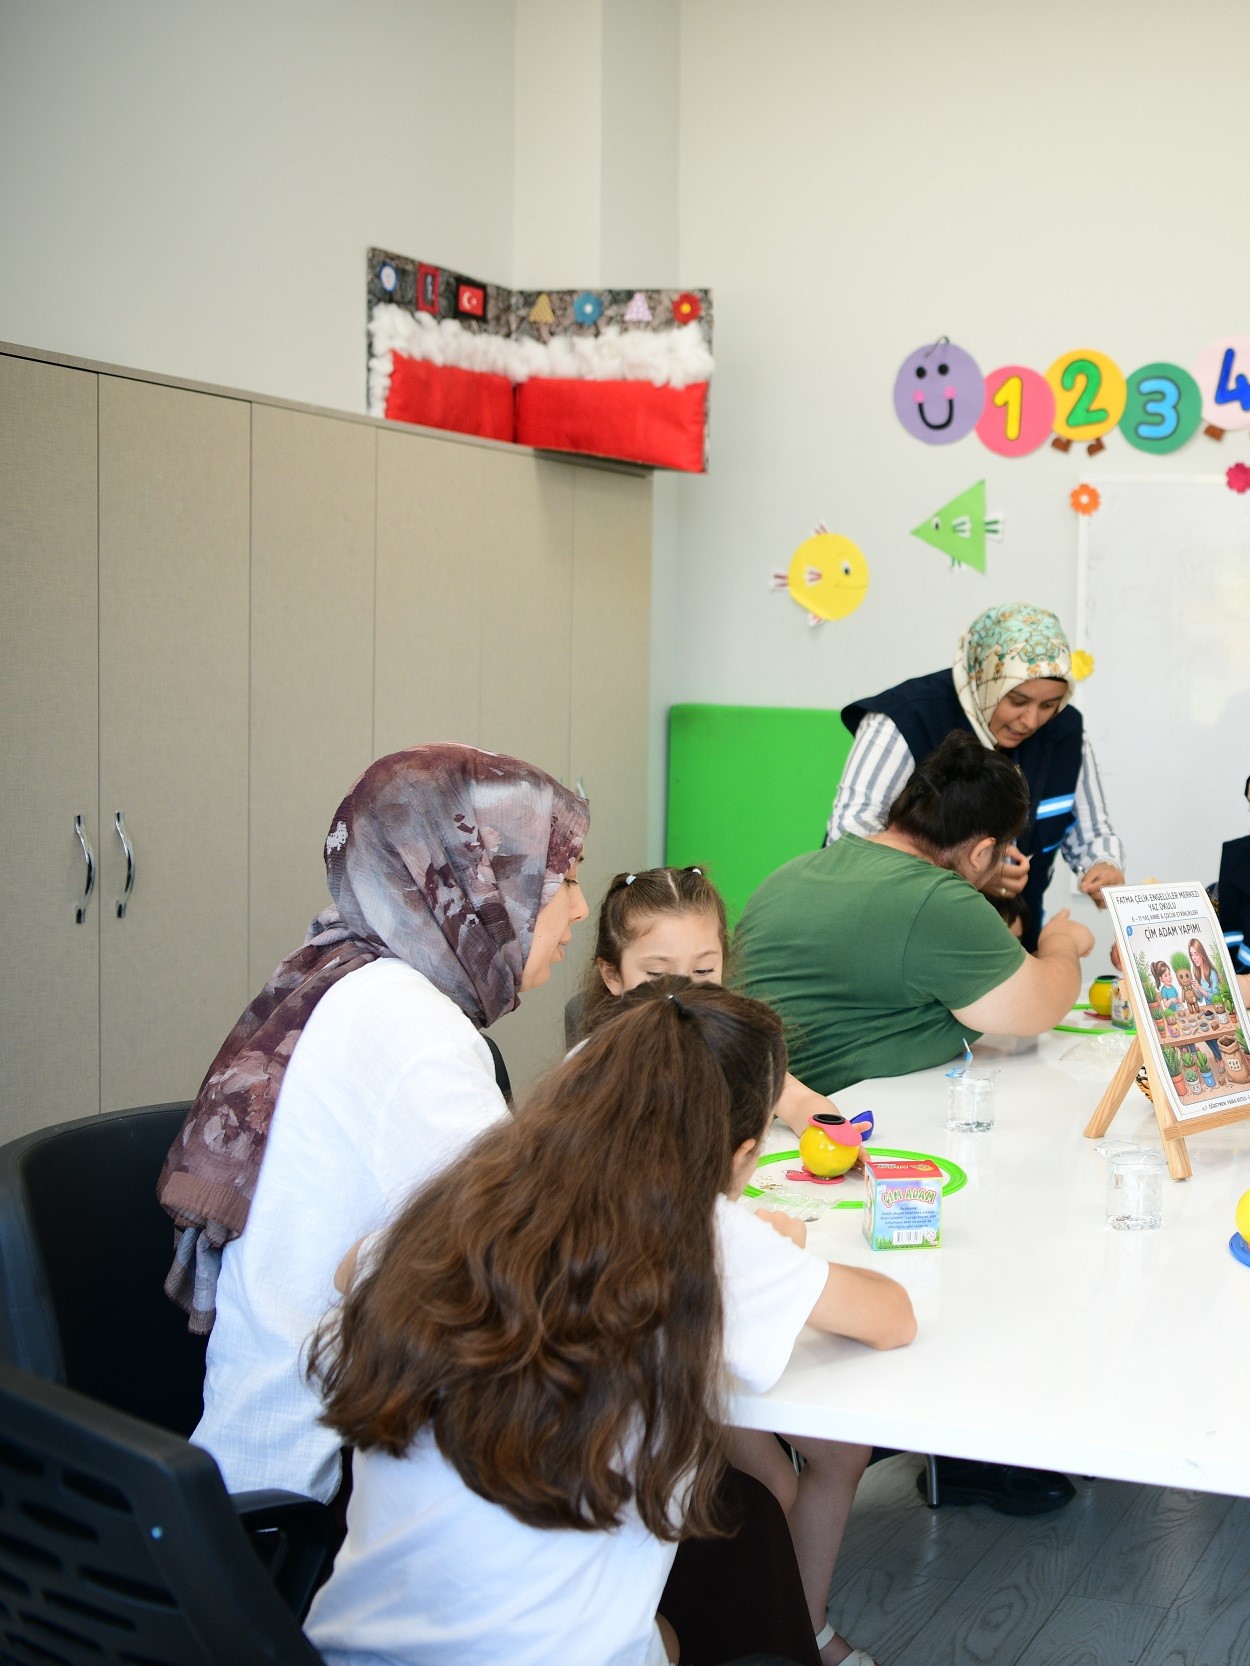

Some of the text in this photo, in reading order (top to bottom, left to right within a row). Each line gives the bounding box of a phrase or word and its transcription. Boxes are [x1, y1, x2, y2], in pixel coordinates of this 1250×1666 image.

[993, 375, 1022, 441] 1
[1061, 359, 1109, 428] 2
[1136, 377, 1180, 440] 3
[1116, 889, 1200, 904] FATMA ÇELİK ENGELLİLER MERKEZİ
[1159, 902, 1177, 911] OKULU
[1144, 923, 1201, 941] ÇİM ADAM YAPIMI
[883, 1188, 936, 1206] ÇİM ADAM
